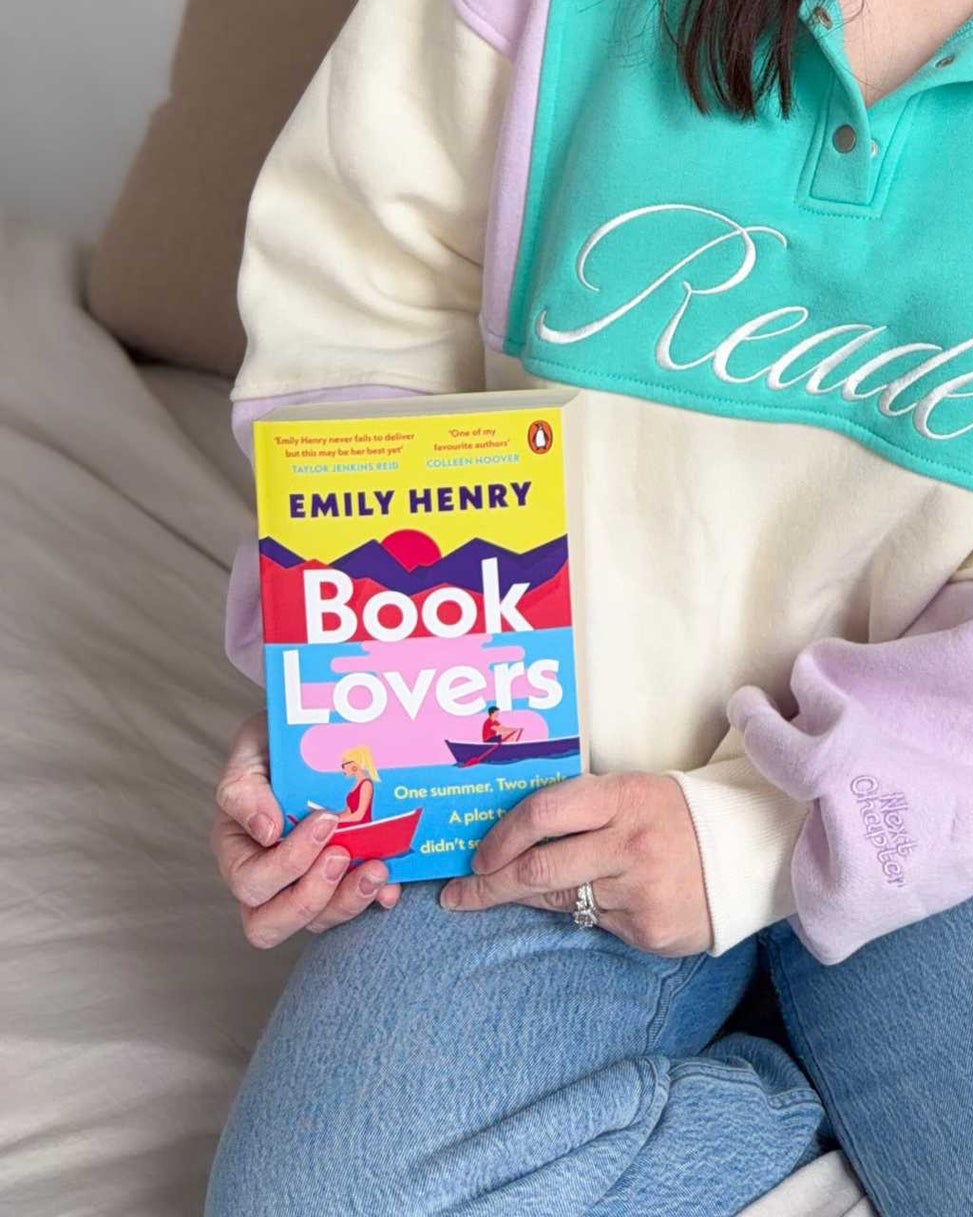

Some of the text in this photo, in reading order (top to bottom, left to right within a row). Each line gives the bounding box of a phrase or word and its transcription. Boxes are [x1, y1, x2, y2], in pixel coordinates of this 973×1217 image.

[301, 436, 326, 445] Henry
[329, 436, 353, 444] never
[354, 434, 372, 442] fails
[373, 434, 383, 442] to
[384, 433, 415, 441] deliver
[472, 427, 481, 436] of
[483, 429, 496, 437] my
[285, 449, 300, 458] but
[301, 448, 317, 457] this
[319, 449, 336, 458] may
[338, 447, 349, 456] be
[350, 447, 365, 455] her
[366, 446, 386, 455] best
[434, 440, 473, 451] favourite
[292, 461, 399, 473] TAYLOR JENKINS REID
[426, 454, 520, 468] COLLEEN HOOVER
[289, 481, 532, 519] EMILY HENRY
[303, 557, 534, 644] Book
[283, 650, 563, 725] Lovers
[394, 785, 428, 799] One
[430, 782, 494, 796] summer.
[496, 777, 527, 790] Two
[449, 810, 462, 824] A
[464, 808, 495, 825] plot
[880, 792, 918, 857] Next
[850, 775, 905, 887] Chapter
[420, 837, 464, 854] didn't
